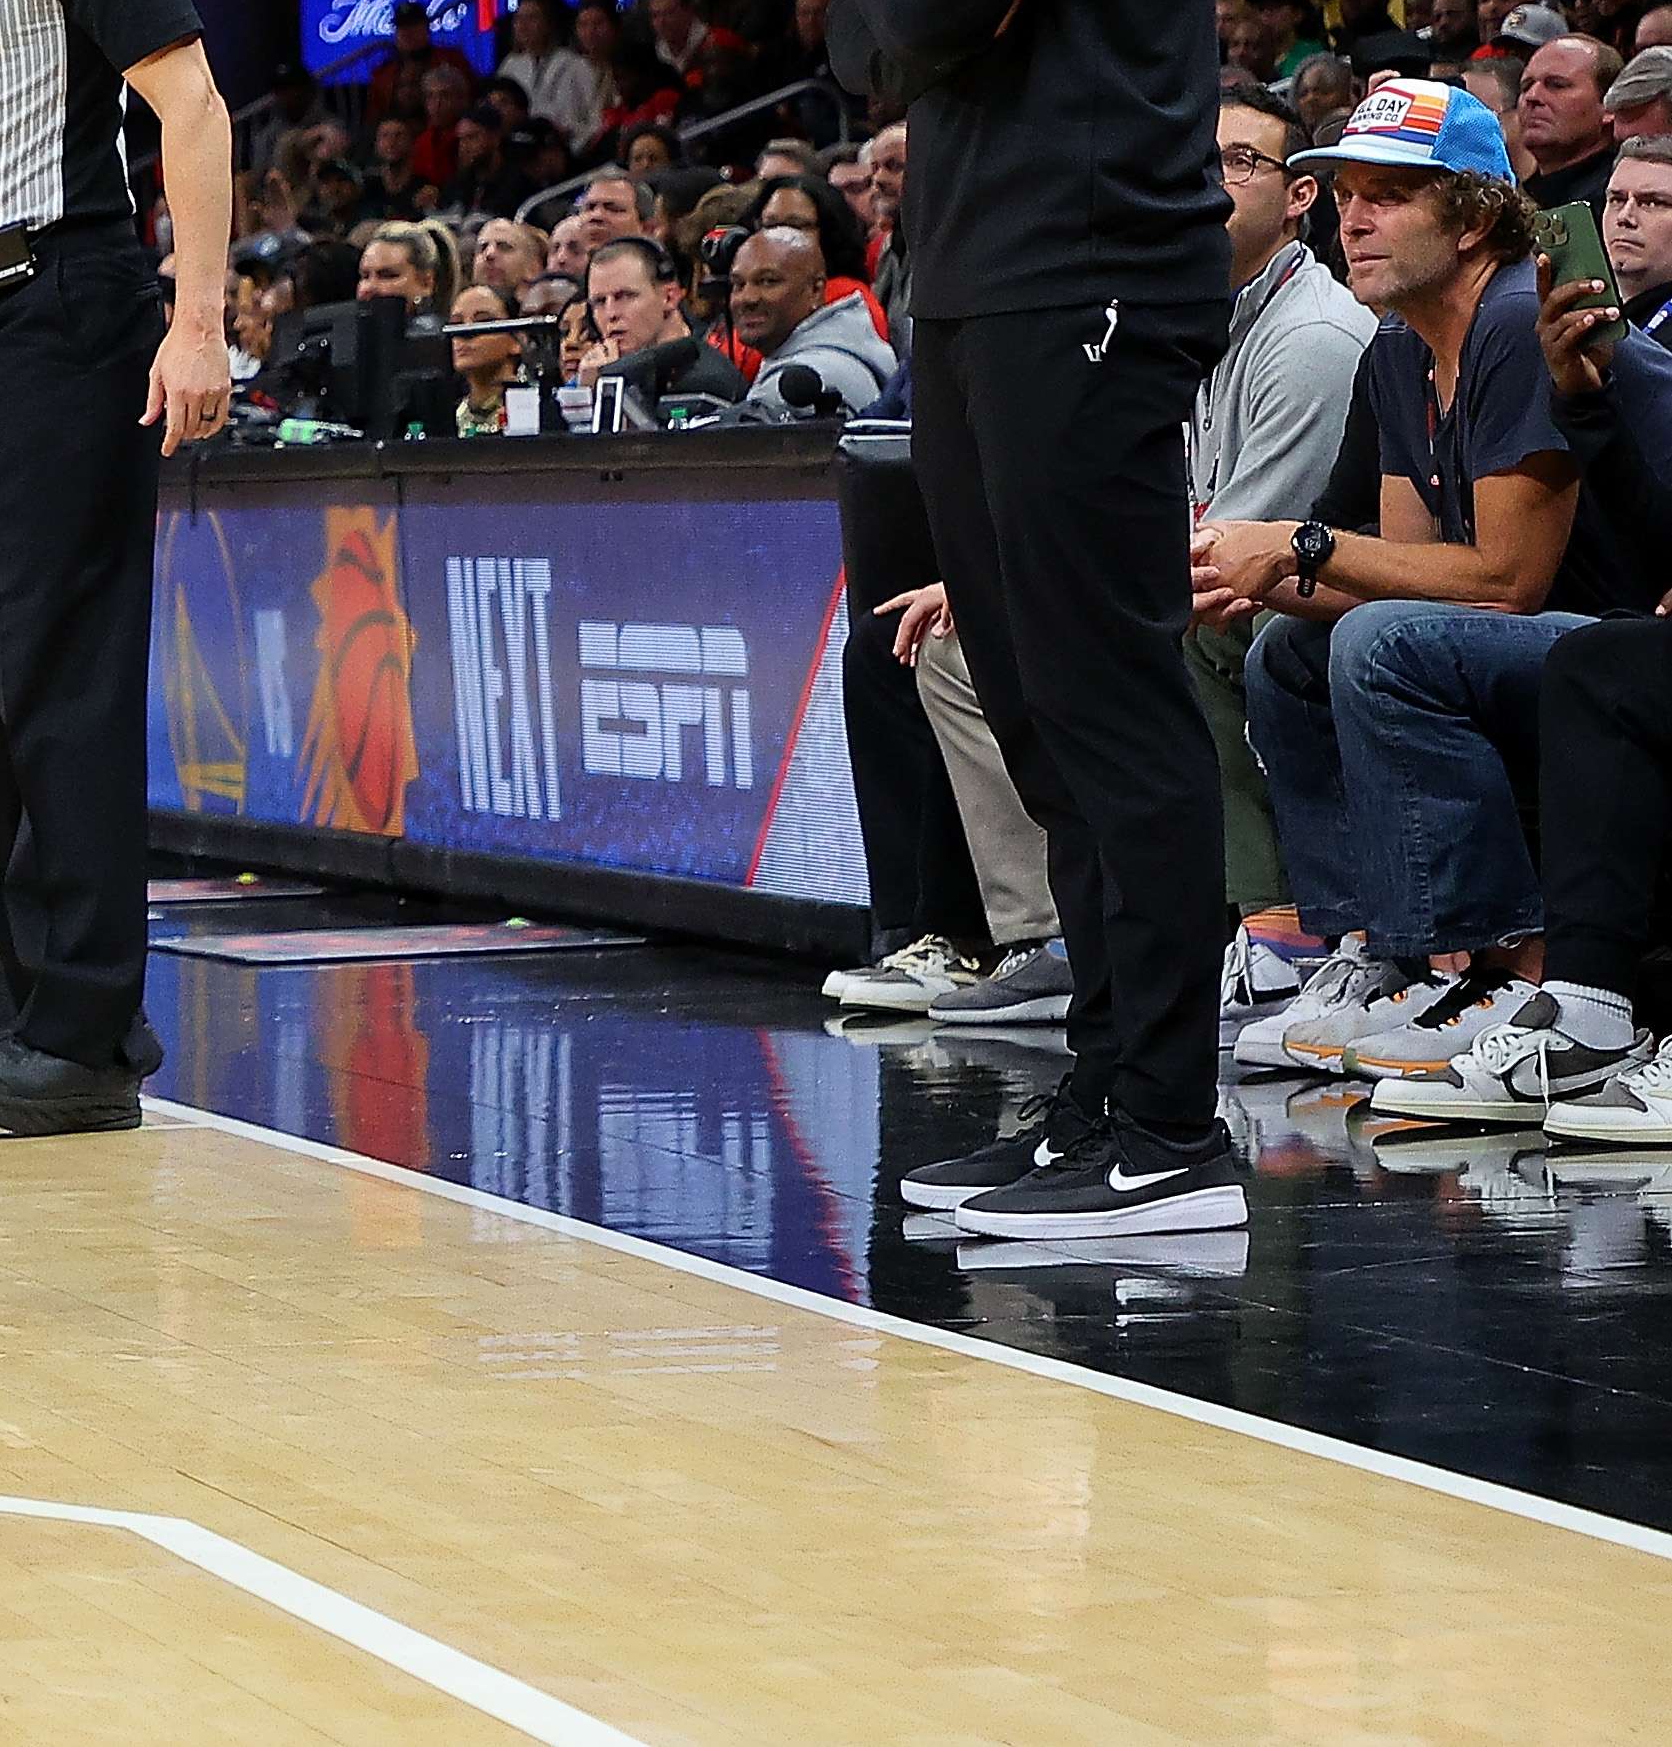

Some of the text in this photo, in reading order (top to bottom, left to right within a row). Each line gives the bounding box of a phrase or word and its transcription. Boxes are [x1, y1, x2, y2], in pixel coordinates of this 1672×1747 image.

[1375, 98, 1408, 114] DAY
[445, 555, 561, 822] NEXT
[578, 619, 754, 790] ESPN
